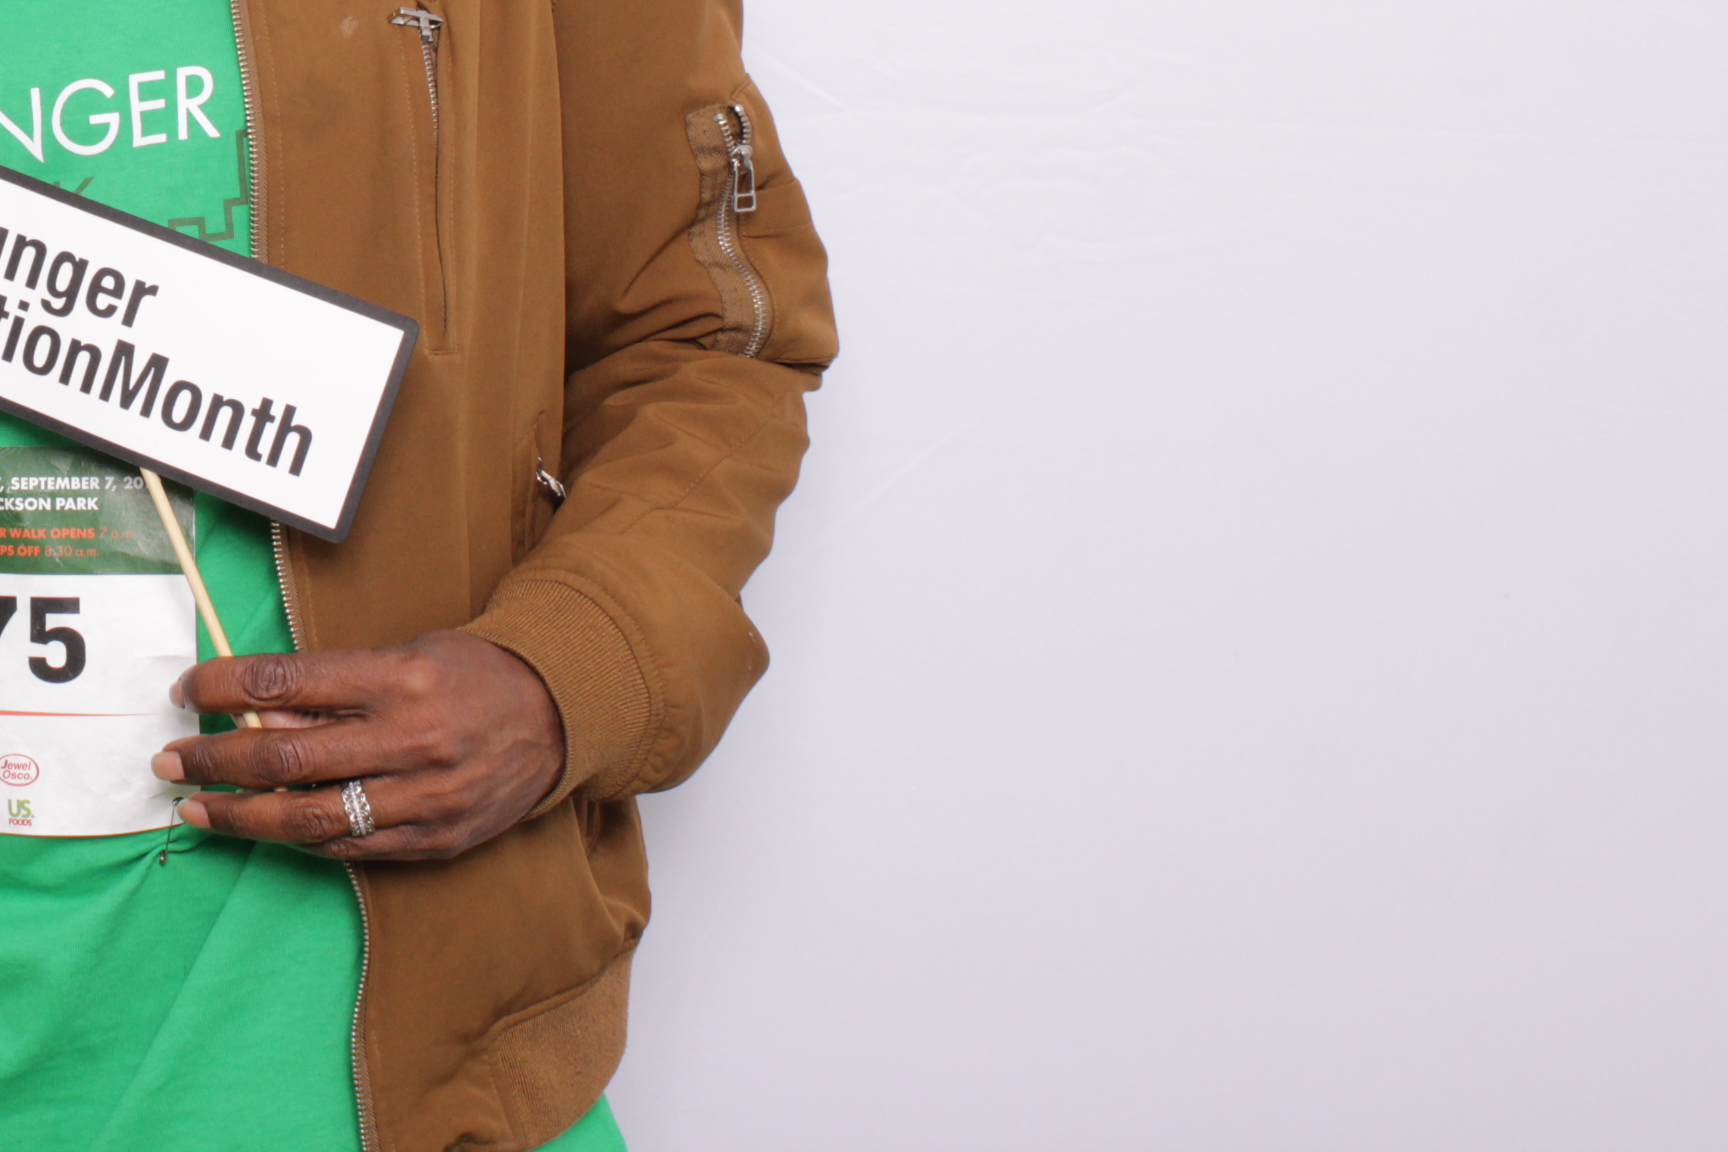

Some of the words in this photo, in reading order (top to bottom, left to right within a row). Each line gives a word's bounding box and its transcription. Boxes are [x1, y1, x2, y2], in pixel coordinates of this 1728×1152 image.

[10, 476, 101, 490] SEPTEMBER
[104, 476, 117, 492] 7,
[55, 497, 100, 511] PARK
[9, 528, 47, 539] WALK
[50, 528, 96, 540] OPENS
[17, 545, 41, 557] OFF
[75, 549, 100, 558] a.m.
[0, 759, 32, 770] Jewel
[8, 817, 32, 827] FOODS
